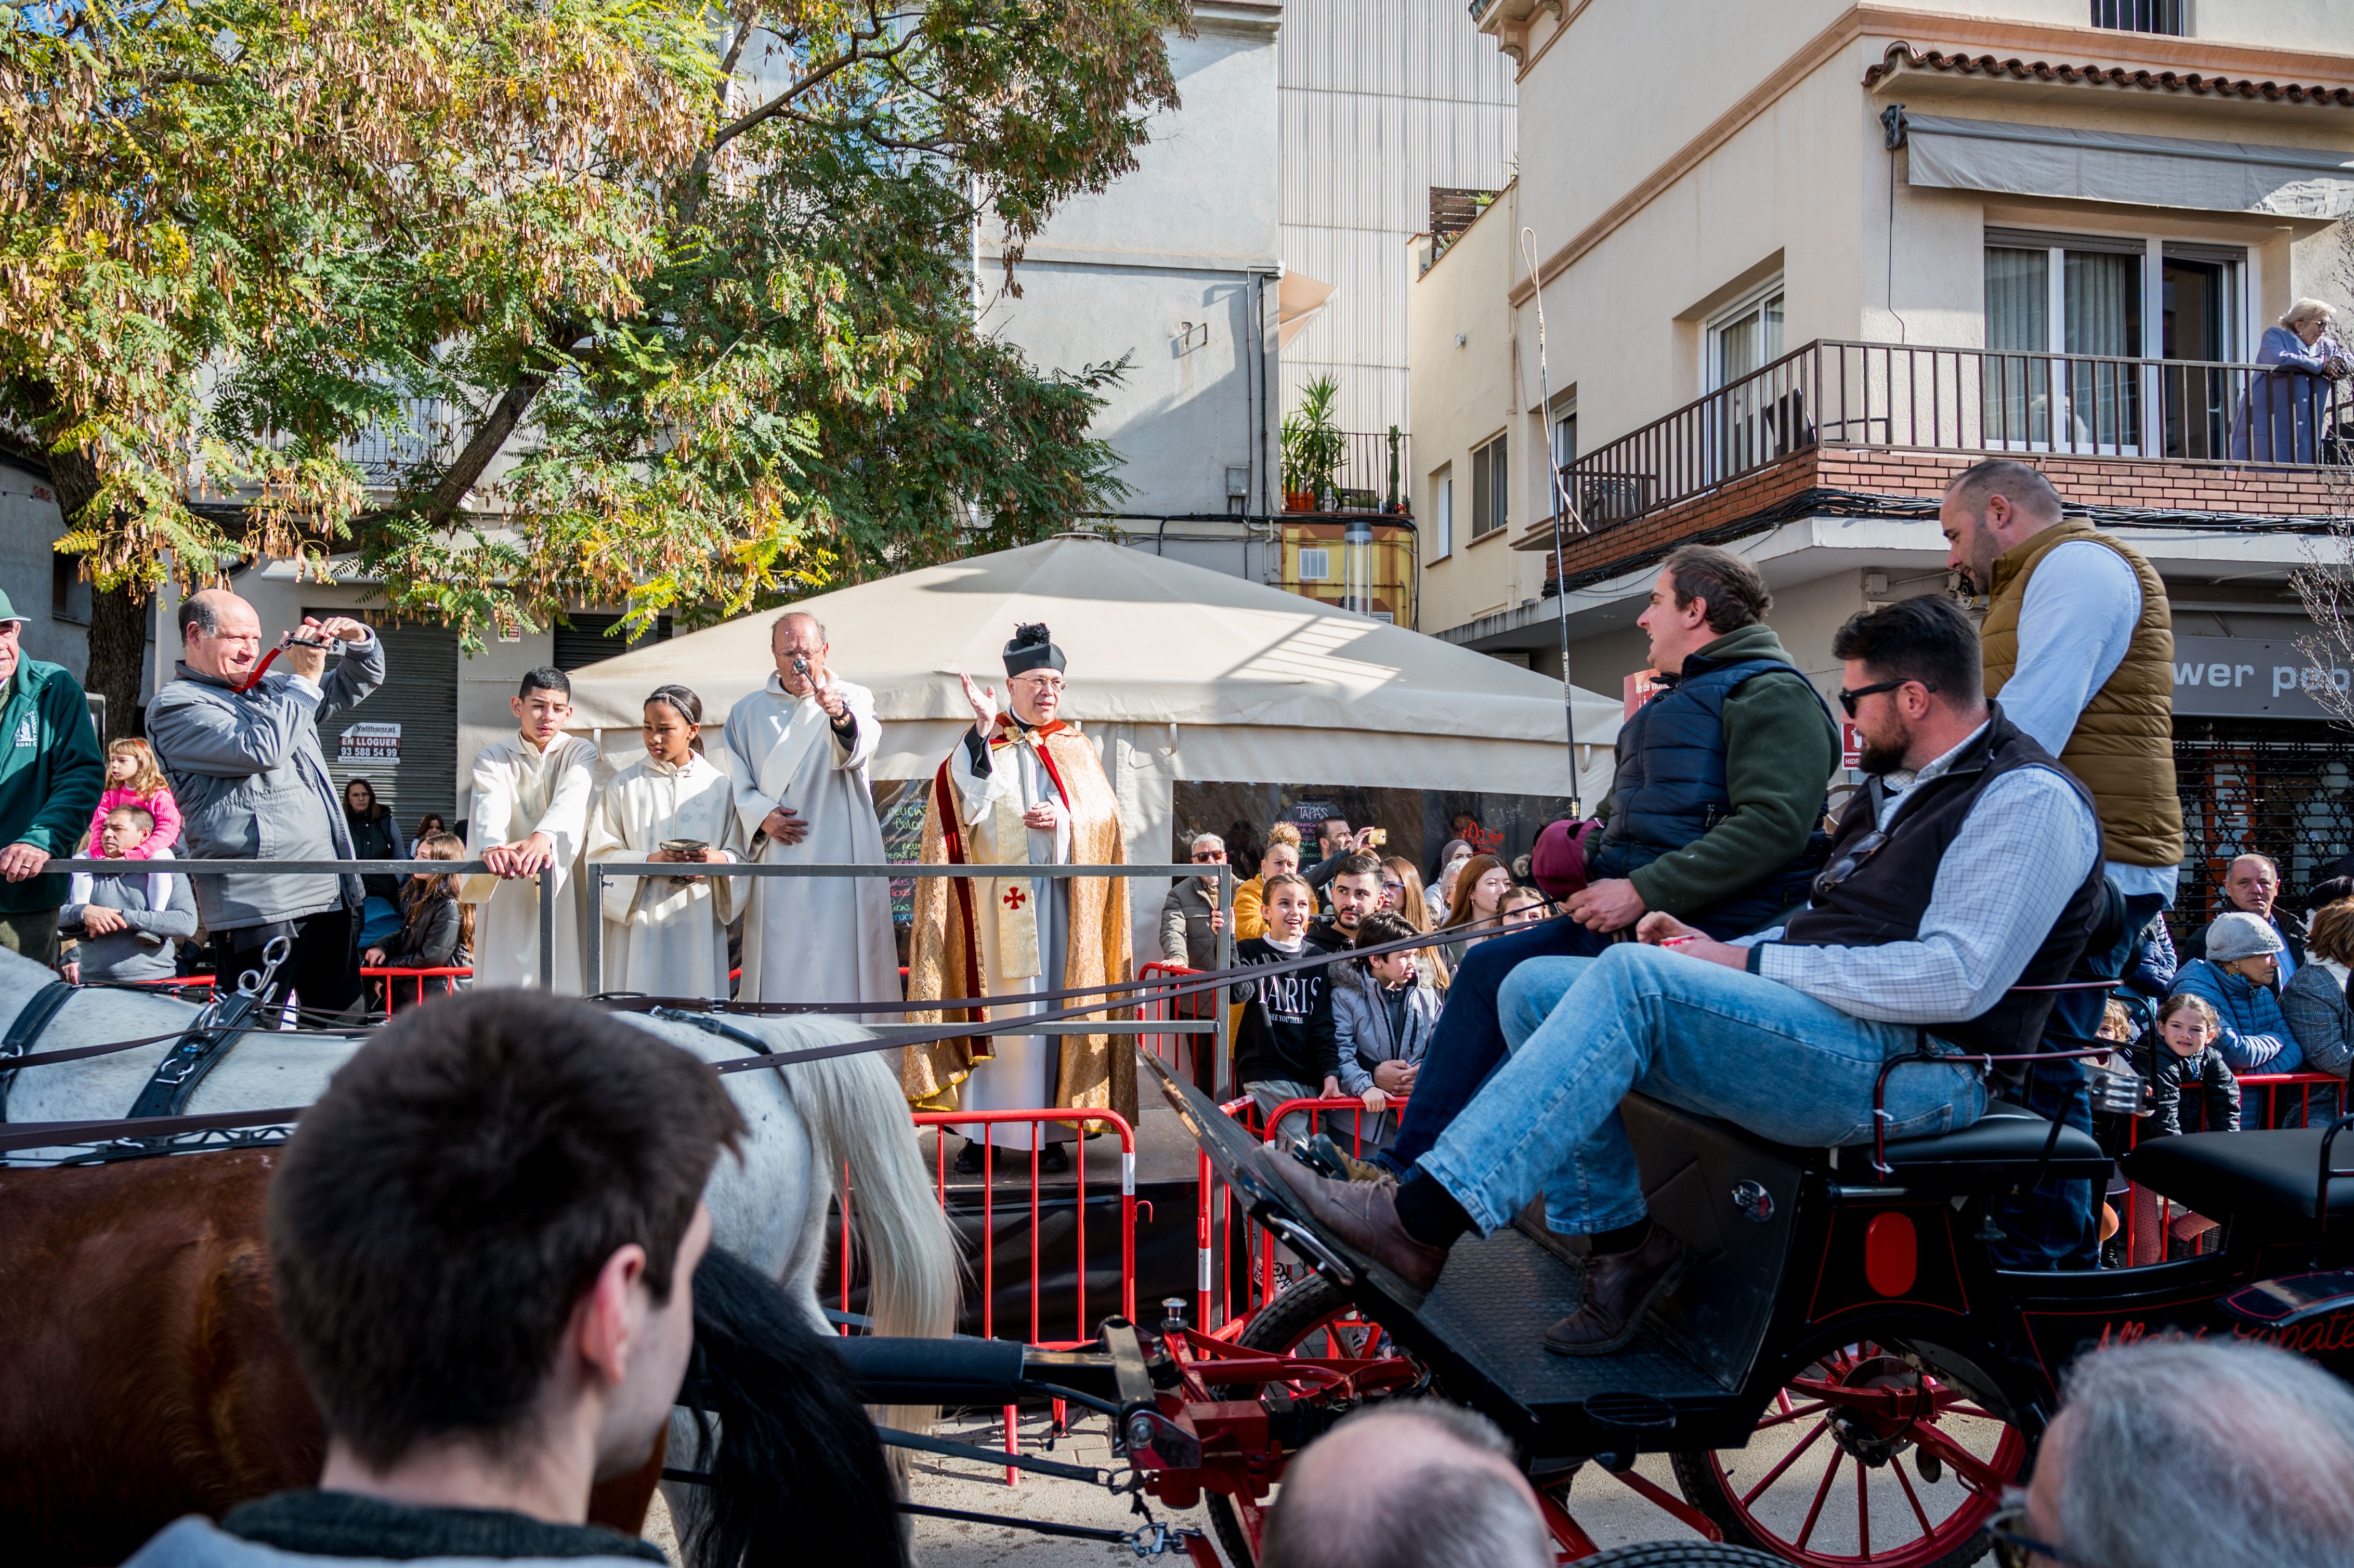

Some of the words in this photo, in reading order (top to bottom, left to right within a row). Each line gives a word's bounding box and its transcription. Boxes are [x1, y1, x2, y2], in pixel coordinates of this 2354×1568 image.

[2272, 665, 2354, 698] peo
[342, 737, 354, 746] EN
[357, 738, 397, 747] LLOGUER
[341, 747, 352, 756] 93
[355, 747, 371, 756] 588
[373, 748, 384, 757] 54
[386, 748, 397, 757] 99
[1296, 806, 1328, 820] TAPAS
[1279, 1015, 1290, 1023] YOU
